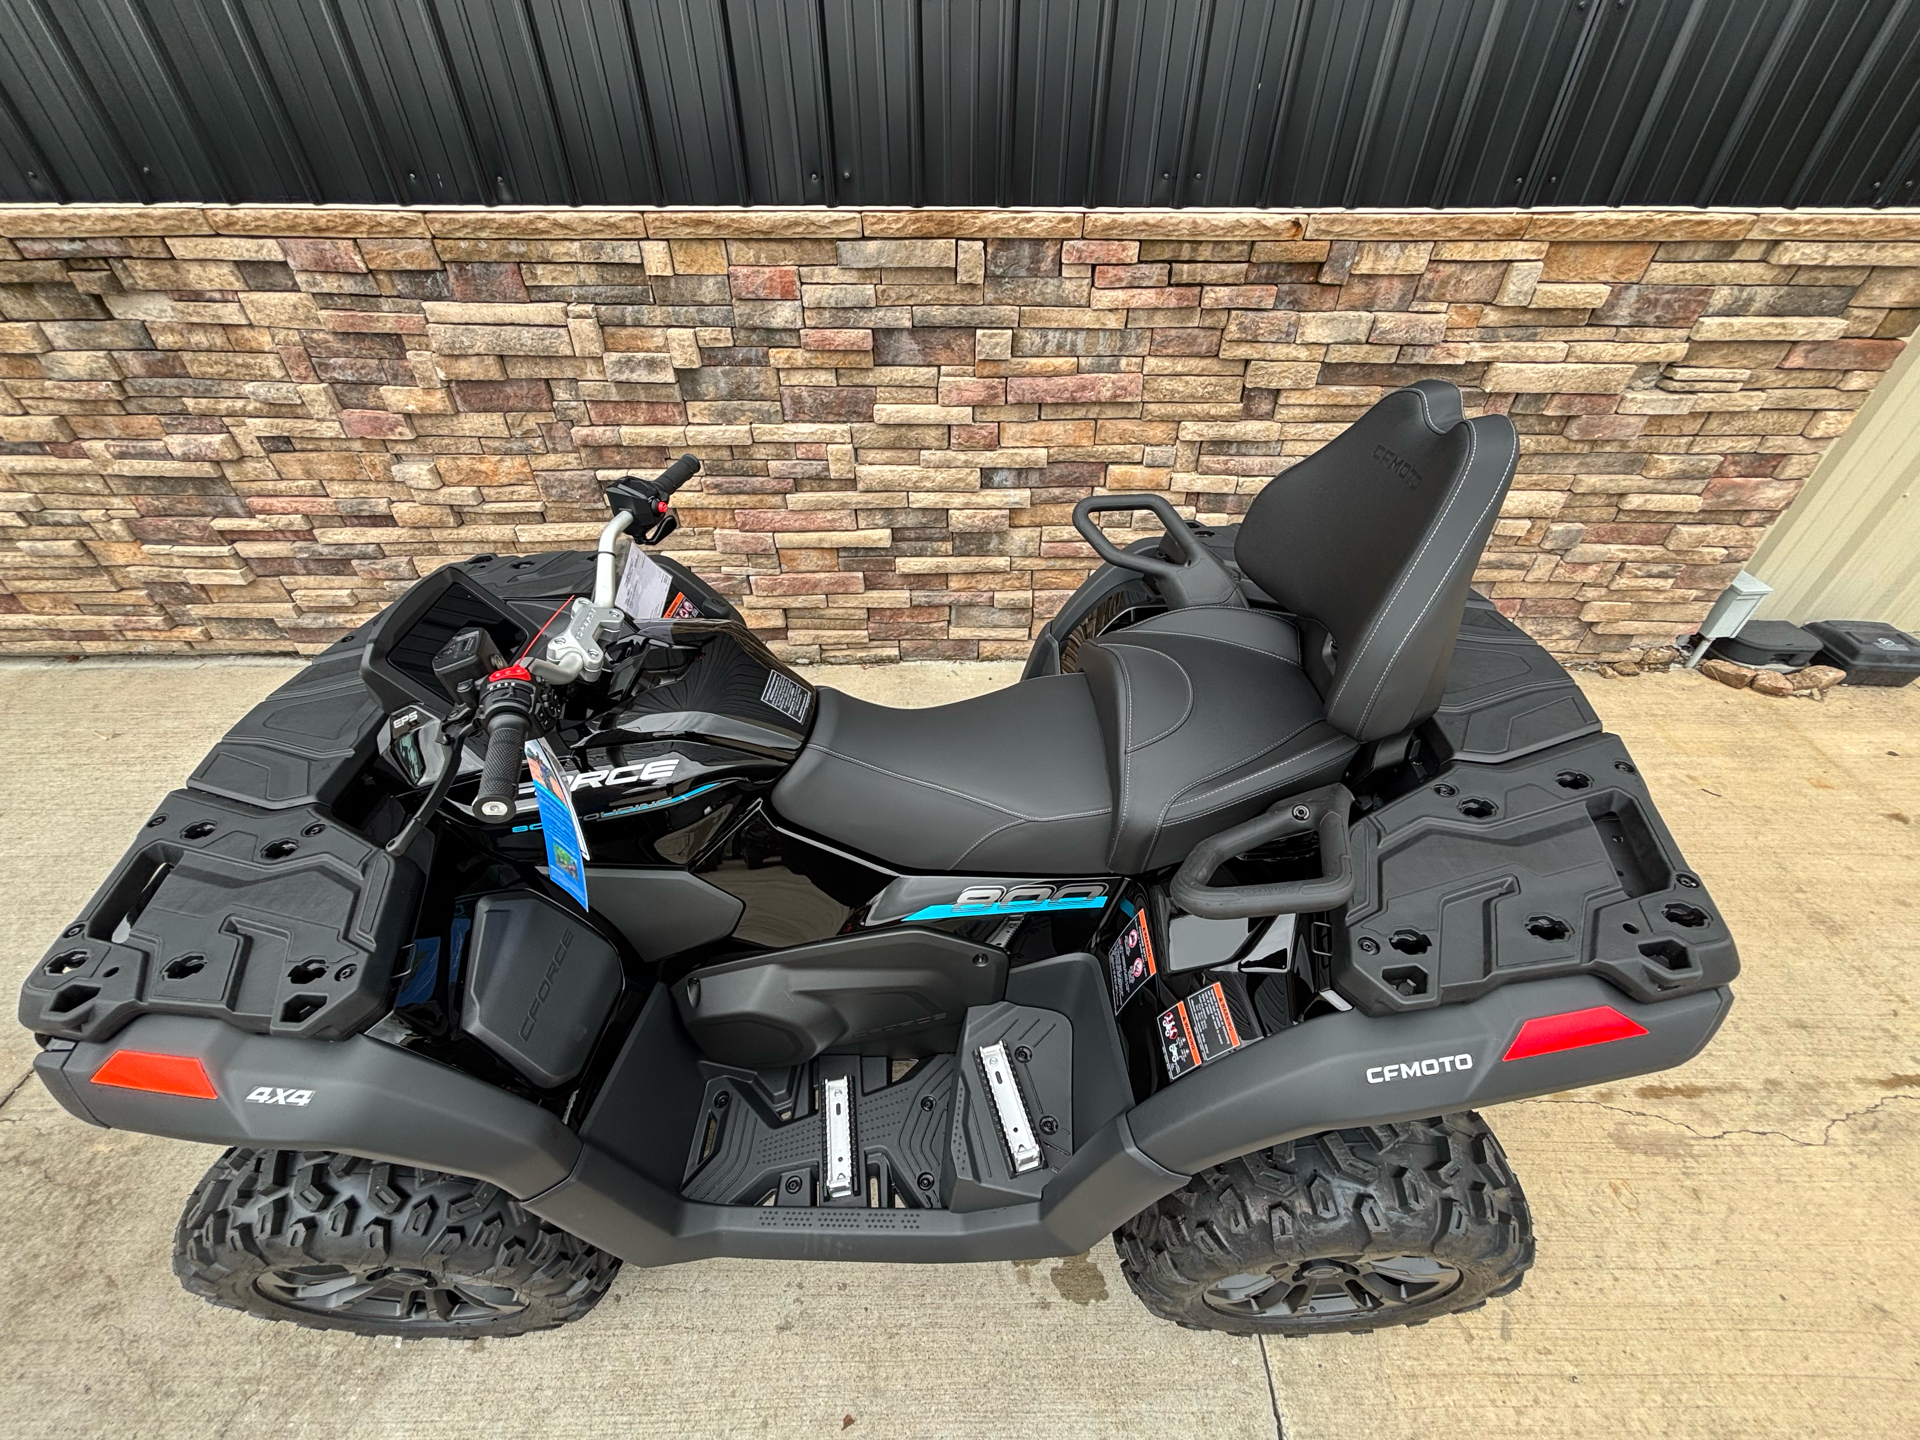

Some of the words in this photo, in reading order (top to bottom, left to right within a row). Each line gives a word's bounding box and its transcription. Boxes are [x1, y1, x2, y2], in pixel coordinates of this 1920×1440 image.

[1372, 445, 1422, 490] CFMOTO
[393, 711, 418, 728] EPS
[519, 928, 575, 1042] CFORCE
[1220, 1003, 1234, 1032] WARNING
[1366, 1053, 1473, 1084] CFMOTO
